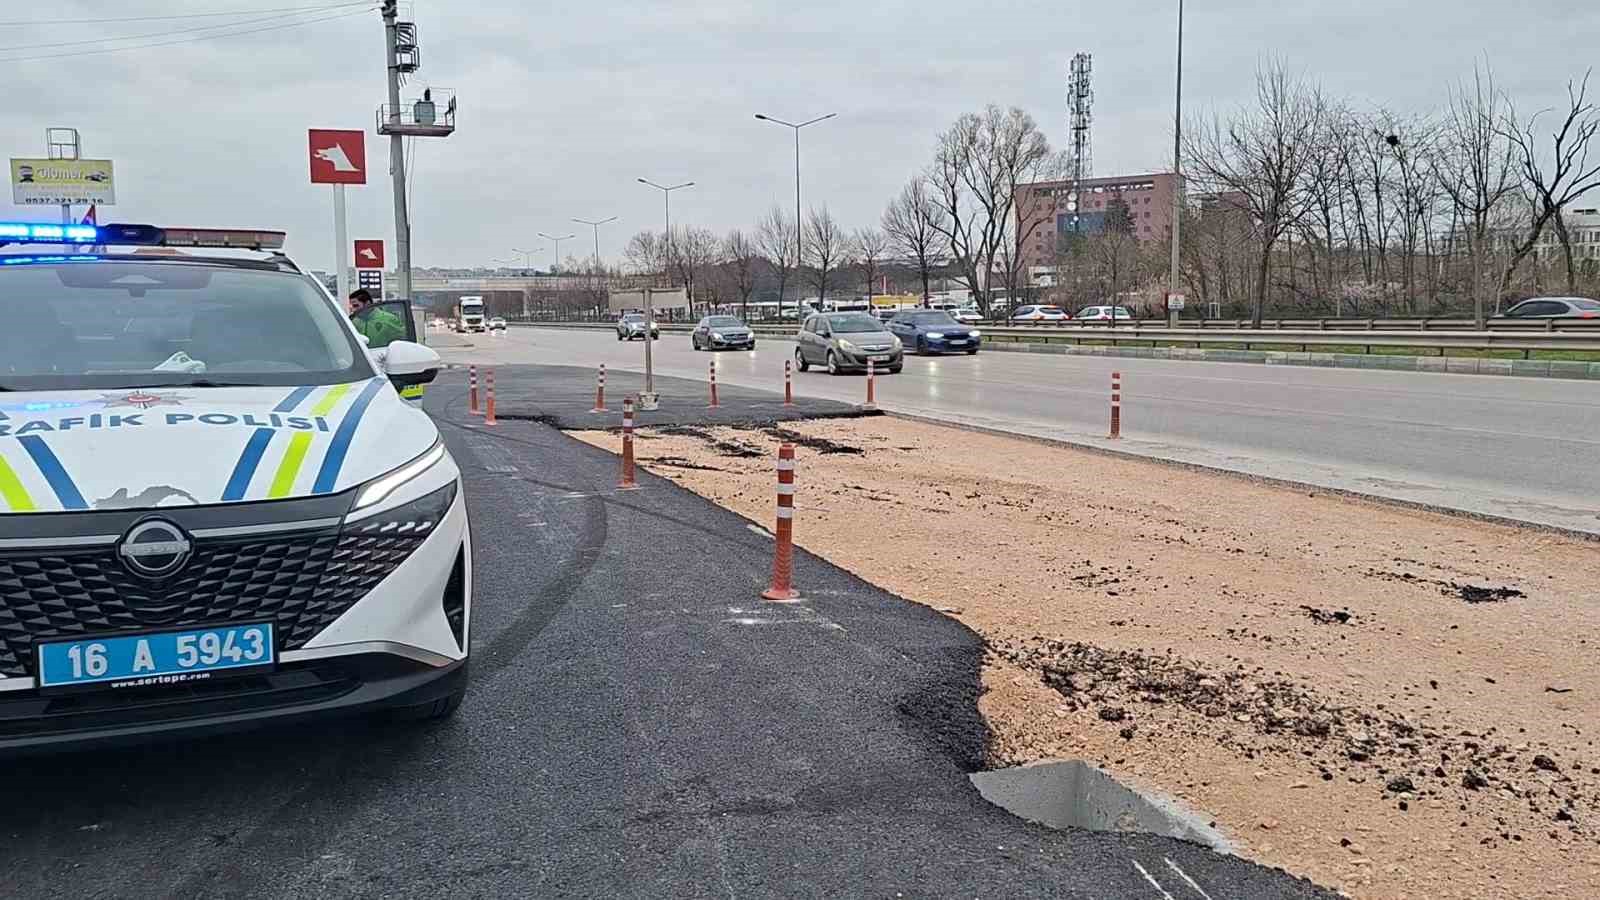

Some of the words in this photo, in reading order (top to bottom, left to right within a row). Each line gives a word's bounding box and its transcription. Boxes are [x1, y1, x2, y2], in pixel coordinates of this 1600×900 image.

[68, 643, 108, 678] 16
[132, 639, 156, 673] A
[176, 628, 264, 668] 5943
